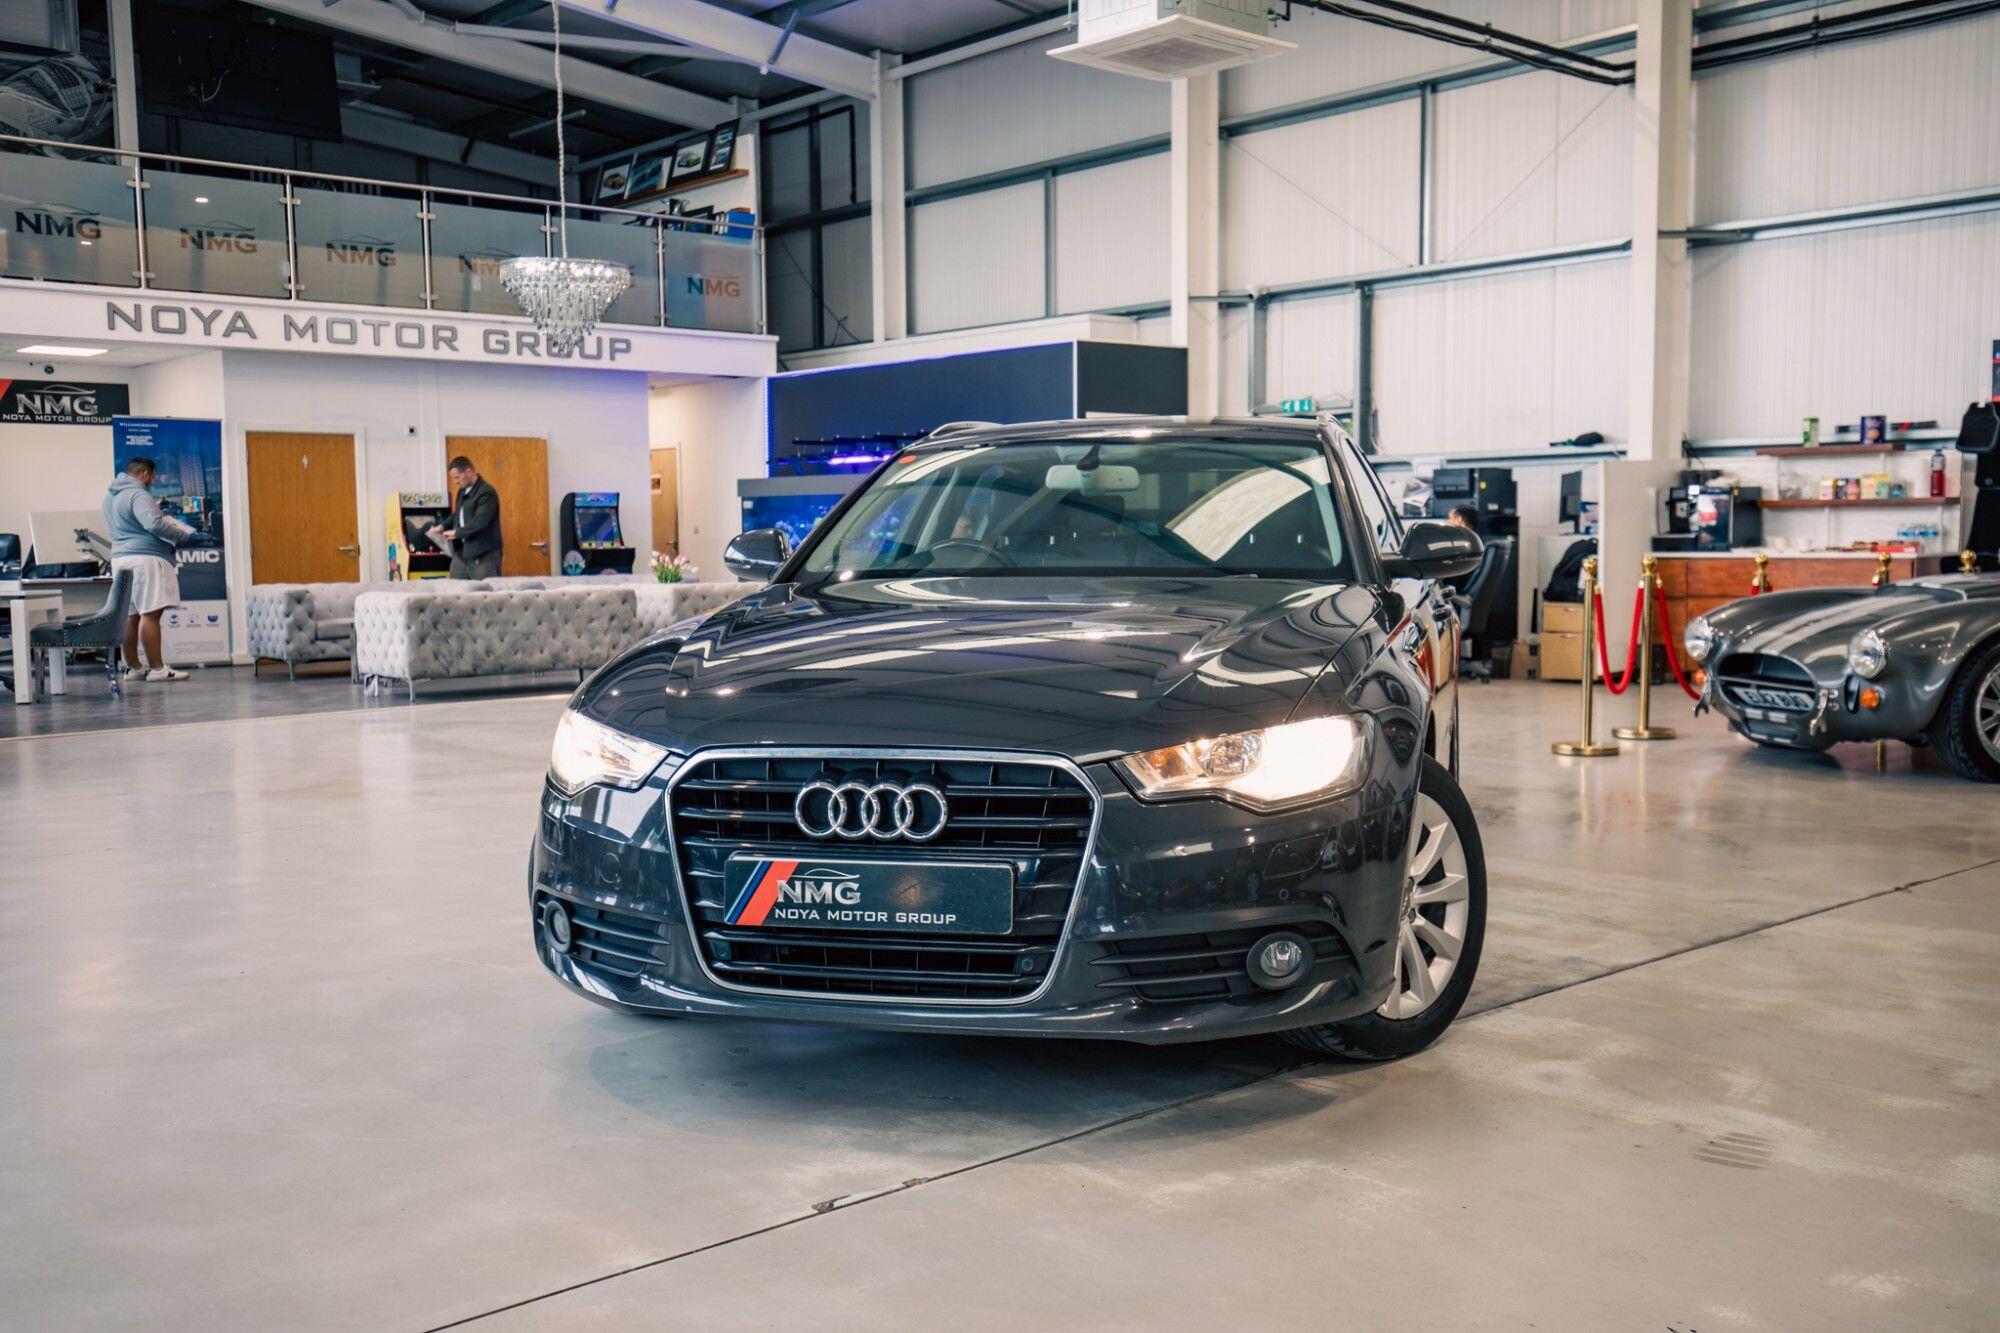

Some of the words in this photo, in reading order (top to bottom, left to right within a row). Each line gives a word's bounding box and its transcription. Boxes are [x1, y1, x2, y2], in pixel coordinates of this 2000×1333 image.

[15, 211, 102, 239] NMG
[179, 227, 258, 254] NMG
[326, 242, 396, 267] NMG
[458, 255, 501, 276] NM
[687, 277, 741, 299] NMG
[106, 302, 258, 339] NOYA
[283, 314, 459, 351] MOTOR
[16, 393, 98, 416] NMG
[35, 415, 73, 423] MOTOR
[777, 880, 861, 905] NMG
[775, 909, 820, 920] NOYA
[827, 910, 888, 923] MOTOR
[895, 912, 957, 925] GROUP
